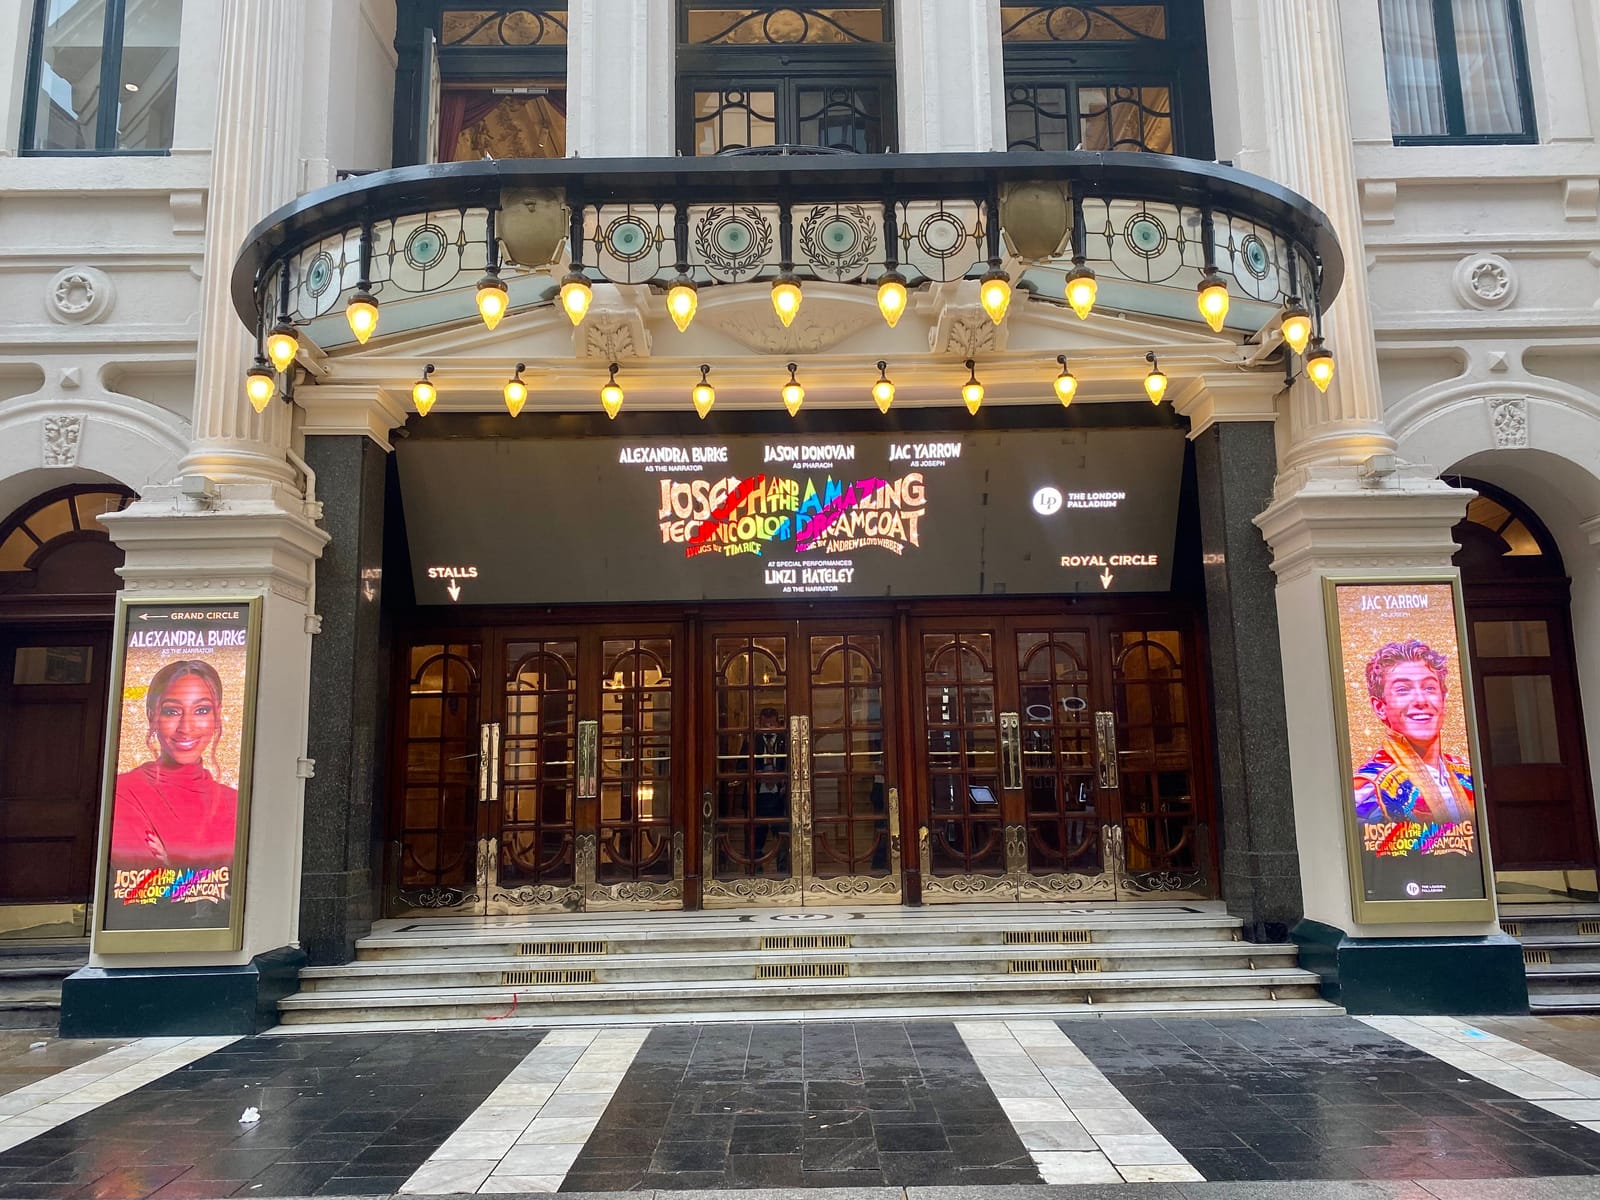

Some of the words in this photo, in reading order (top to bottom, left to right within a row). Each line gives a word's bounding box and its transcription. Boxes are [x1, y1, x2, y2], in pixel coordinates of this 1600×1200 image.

[619, 446, 690, 463] ALEXANDRA
[691, 446, 728, 463] BURKE
[763, 445, 799, 462] JASON
[801, 444, 855, 460] DONOVAN
[889, 444, 911, 461] JAC
[913, 442, 962, 459] YARROW
[668, 464, 703, 472] NARRATOR
[910, 460, 920, 468] AS
[767, 476, 800, 497] AND
[798, 472, 928, 515] AMAZING
[1068, 492, 1086, 500] THE
[1087, 491, 1126, 500] LONDON
[659, 473, 768, 522] JOSEPH
[767, 494, 800, 512] THE
[1067, 500, 1117, 508] PALLADIUM
[659, 514, 791, 544] TECHNICOLOR
[795, 507, 926, 548] DREAMCOAT
[686, 545, 712, 558] LYRICS
[723, 543, 743, 557] TIM
[743, 541, 763, 557] RICE
[795, 541, 817, 553] MUSIC
[826, 538, 860, 554] ANDREW
[859, 537, 878, 547] LLOYD
[877, 537, 905, 556] WEBBER
[1061, 556, 1107, 567] ROYAL
[1109, 554, 1158, 566] CIRCLE
[428, 566, 478, 578] STALLS
[764, 568, 797, 585] LINZI
[802, 567, 855, 584] HATELEY
[1361, 595, 1382, 611] JAC
[1382, 594, 1428, 609] YARROW
[170, 612, 204, 620] GRAND
[206, 611, 240, 620] CIRCLE
[129, 629, 205, 648] ALEXANDRA
[207, 629, 246, 646] BURKE
[1364, 821, 1408, 842] JOSEPH
[1408, 829, 1422, 838] THE
[1420, 820, 1474, 838] AMAZING
[1420, 835, 1474, 854] DREAMCOAT
[114, 867, 162, 889] JOSEPH
[161, 868, 176, 879] AND
[161, 876, 176, 885] THE
[174, 866, 230, 886] AMAZING
[171, 882, 229, 900] DREAMCOAT
